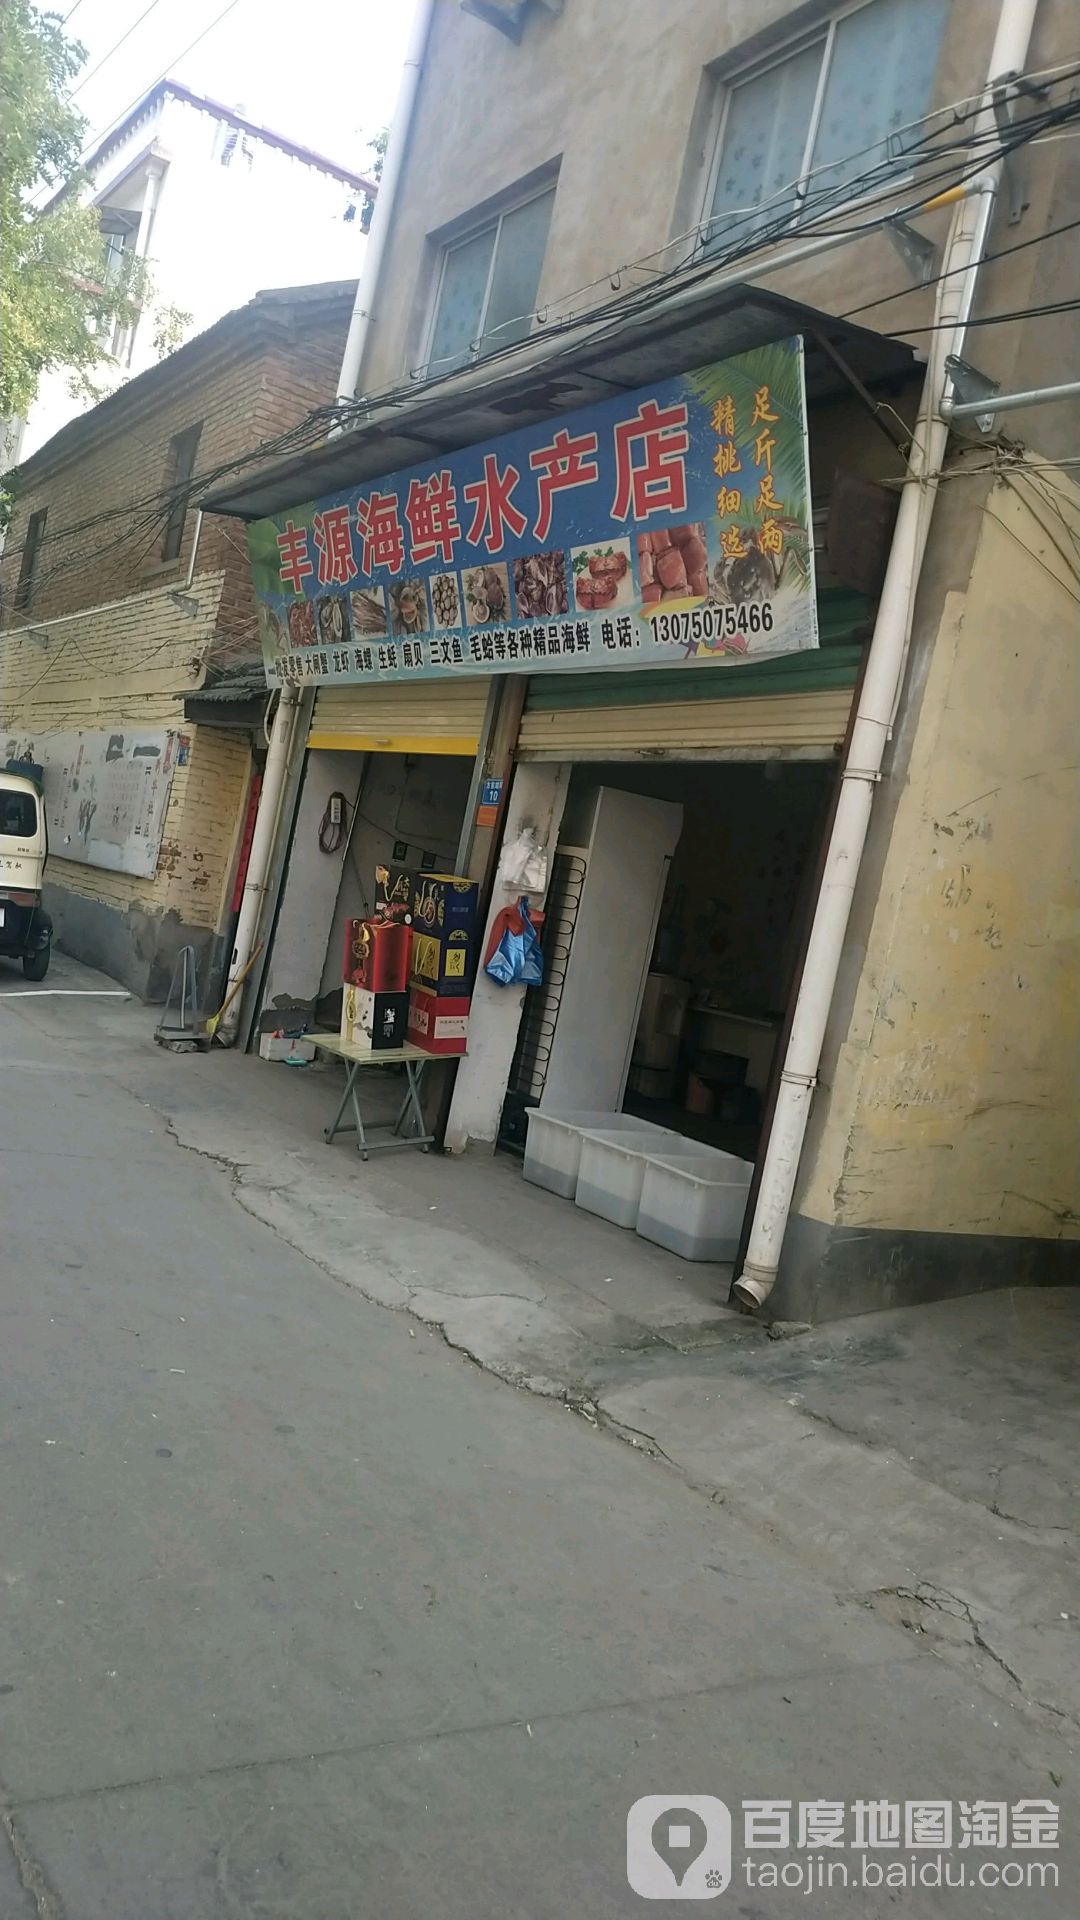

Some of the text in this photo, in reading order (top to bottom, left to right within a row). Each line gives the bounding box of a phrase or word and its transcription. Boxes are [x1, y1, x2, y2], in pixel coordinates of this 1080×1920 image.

[276, 399, 690, 594] 丰源海鲜水产店
[709, 394, 749, 559] 精挑细选
[751, 385, 785, 556] 足斤足两
[305, 652, 329, 676] 大闸蟹
[333, 648, 350, 673] 龙虾
[354, 646, 374, 672] 海螺
[378, 643, 398, 670] 生蚝
[403, 639, 424, 668] 扇贝
[430, 635, 464, 664] 三文鱼
[469, 621, 591, 662] 毛蛤等各种精品海鲜
[650, 602, 774, 643] 13075075466
[490, 790, 499, 801] 10
